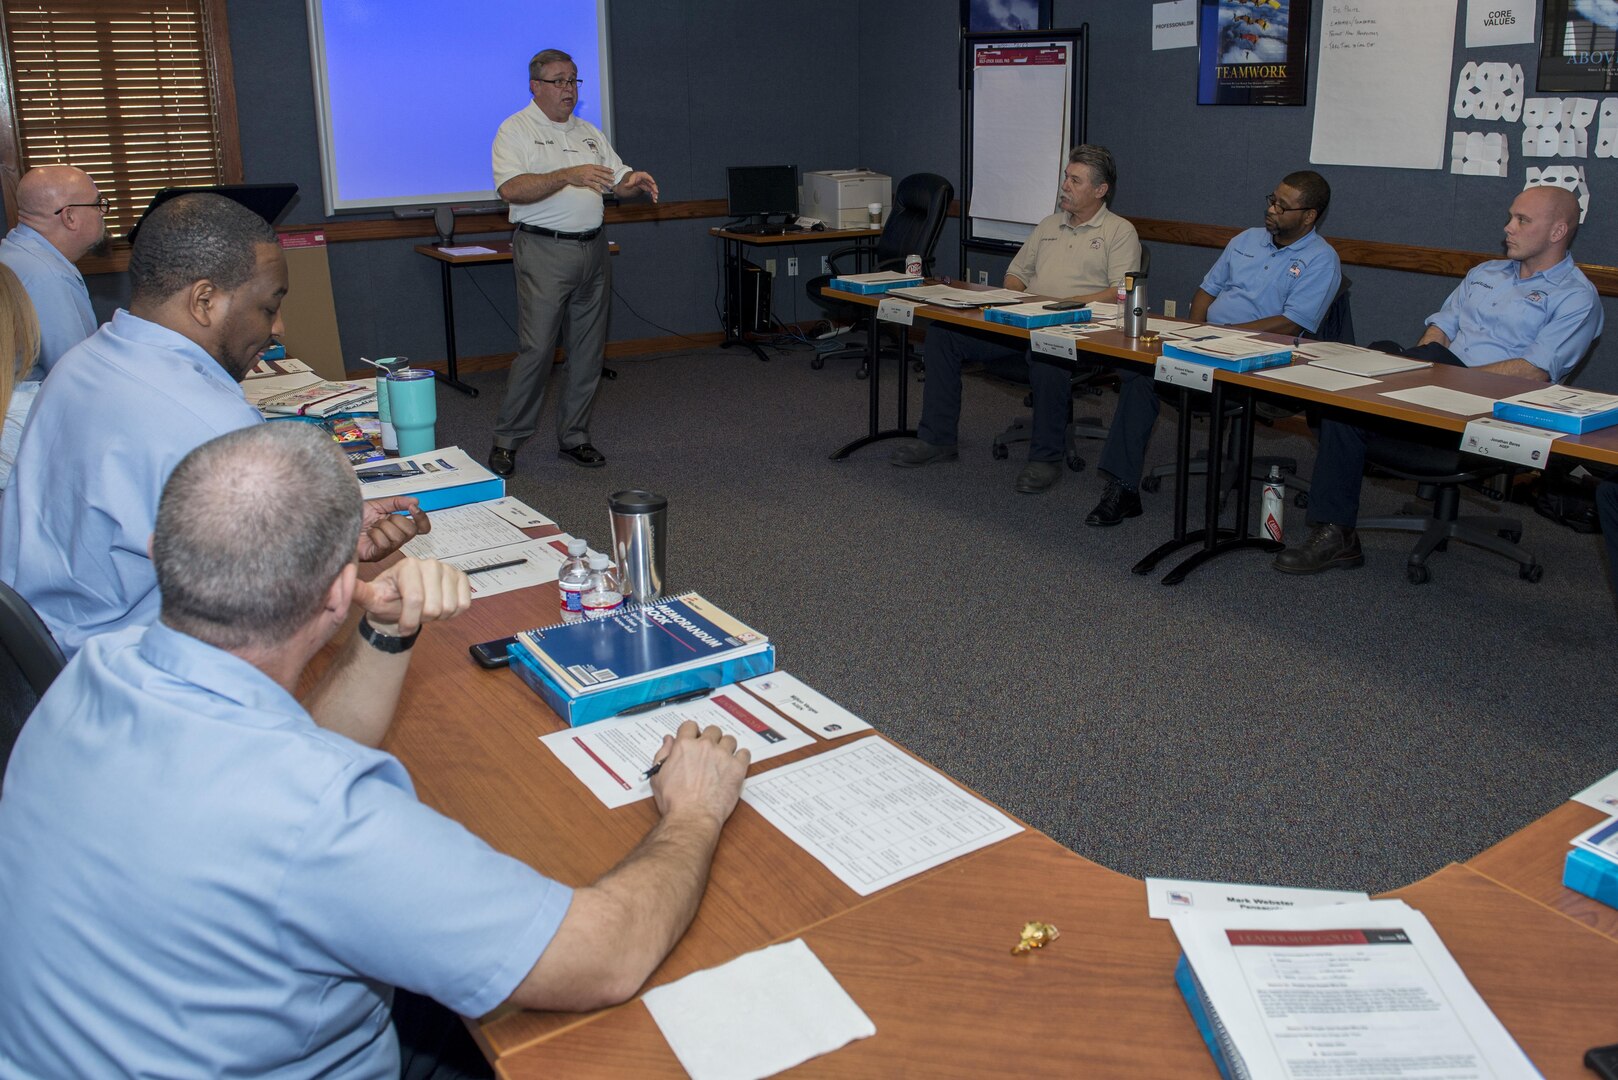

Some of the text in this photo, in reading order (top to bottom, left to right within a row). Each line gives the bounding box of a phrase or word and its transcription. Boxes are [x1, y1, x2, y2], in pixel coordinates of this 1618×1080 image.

[1488, 10, 1512, 19] CORE
[1155, 20, 1194, 30] PROFESSIONALISM
[1483, 17, 1516, 27] VALUES
[1215, 65, 1287, 79] TEAMWORK
[1490, 437, 1509, 445] Jonathan
[642, 606, 673, 625] BOOK
[655, 604, 723, 648] MEMORANDUM
[1226, 896, 1295, 907] Mark Webster
[1238, 933, 1355, 944] LEADERSHIP GOLD
